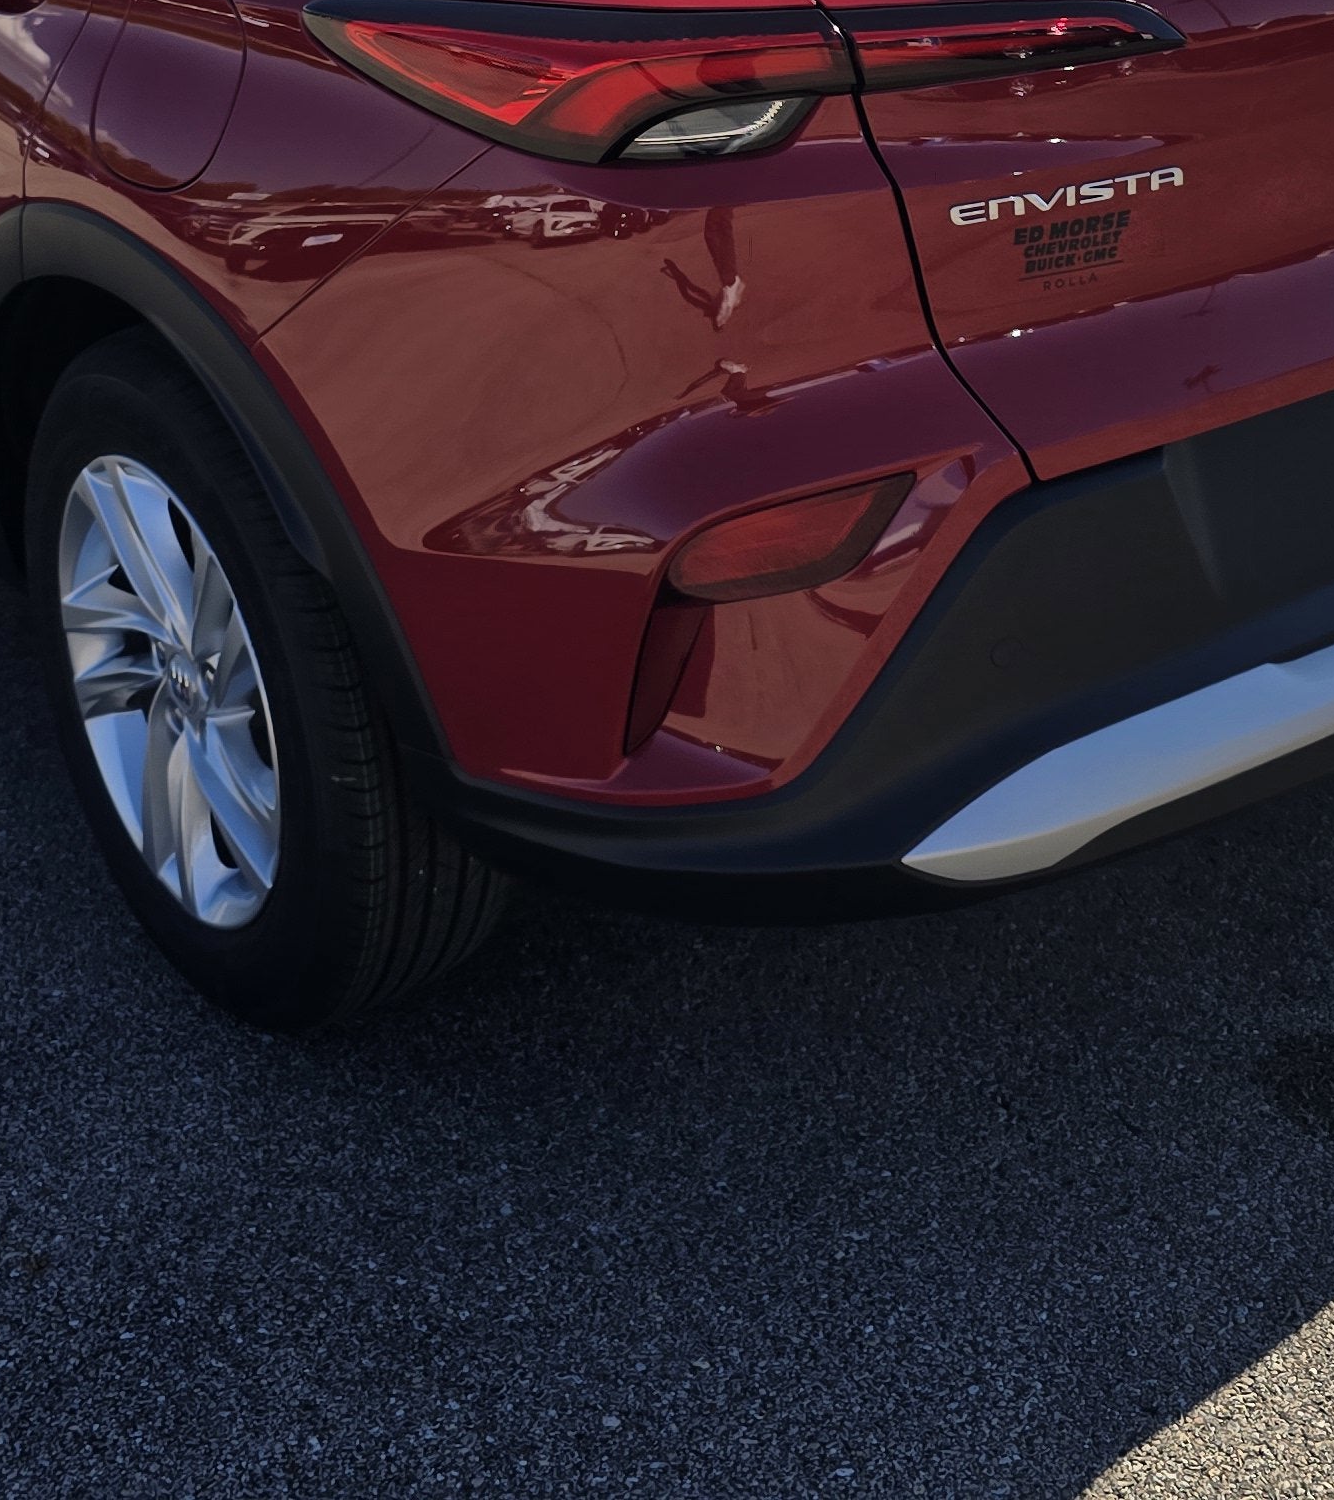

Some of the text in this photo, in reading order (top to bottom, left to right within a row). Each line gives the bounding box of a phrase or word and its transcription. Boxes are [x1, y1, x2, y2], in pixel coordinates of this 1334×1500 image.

[949, 167, 1184, 226] ENVISTA
[1013, 209, 1132, 245] ED MORSE
[1022, 230, 1123, 260] CHEVROLET
[1042, 272, 1099, 292] ROLLA
